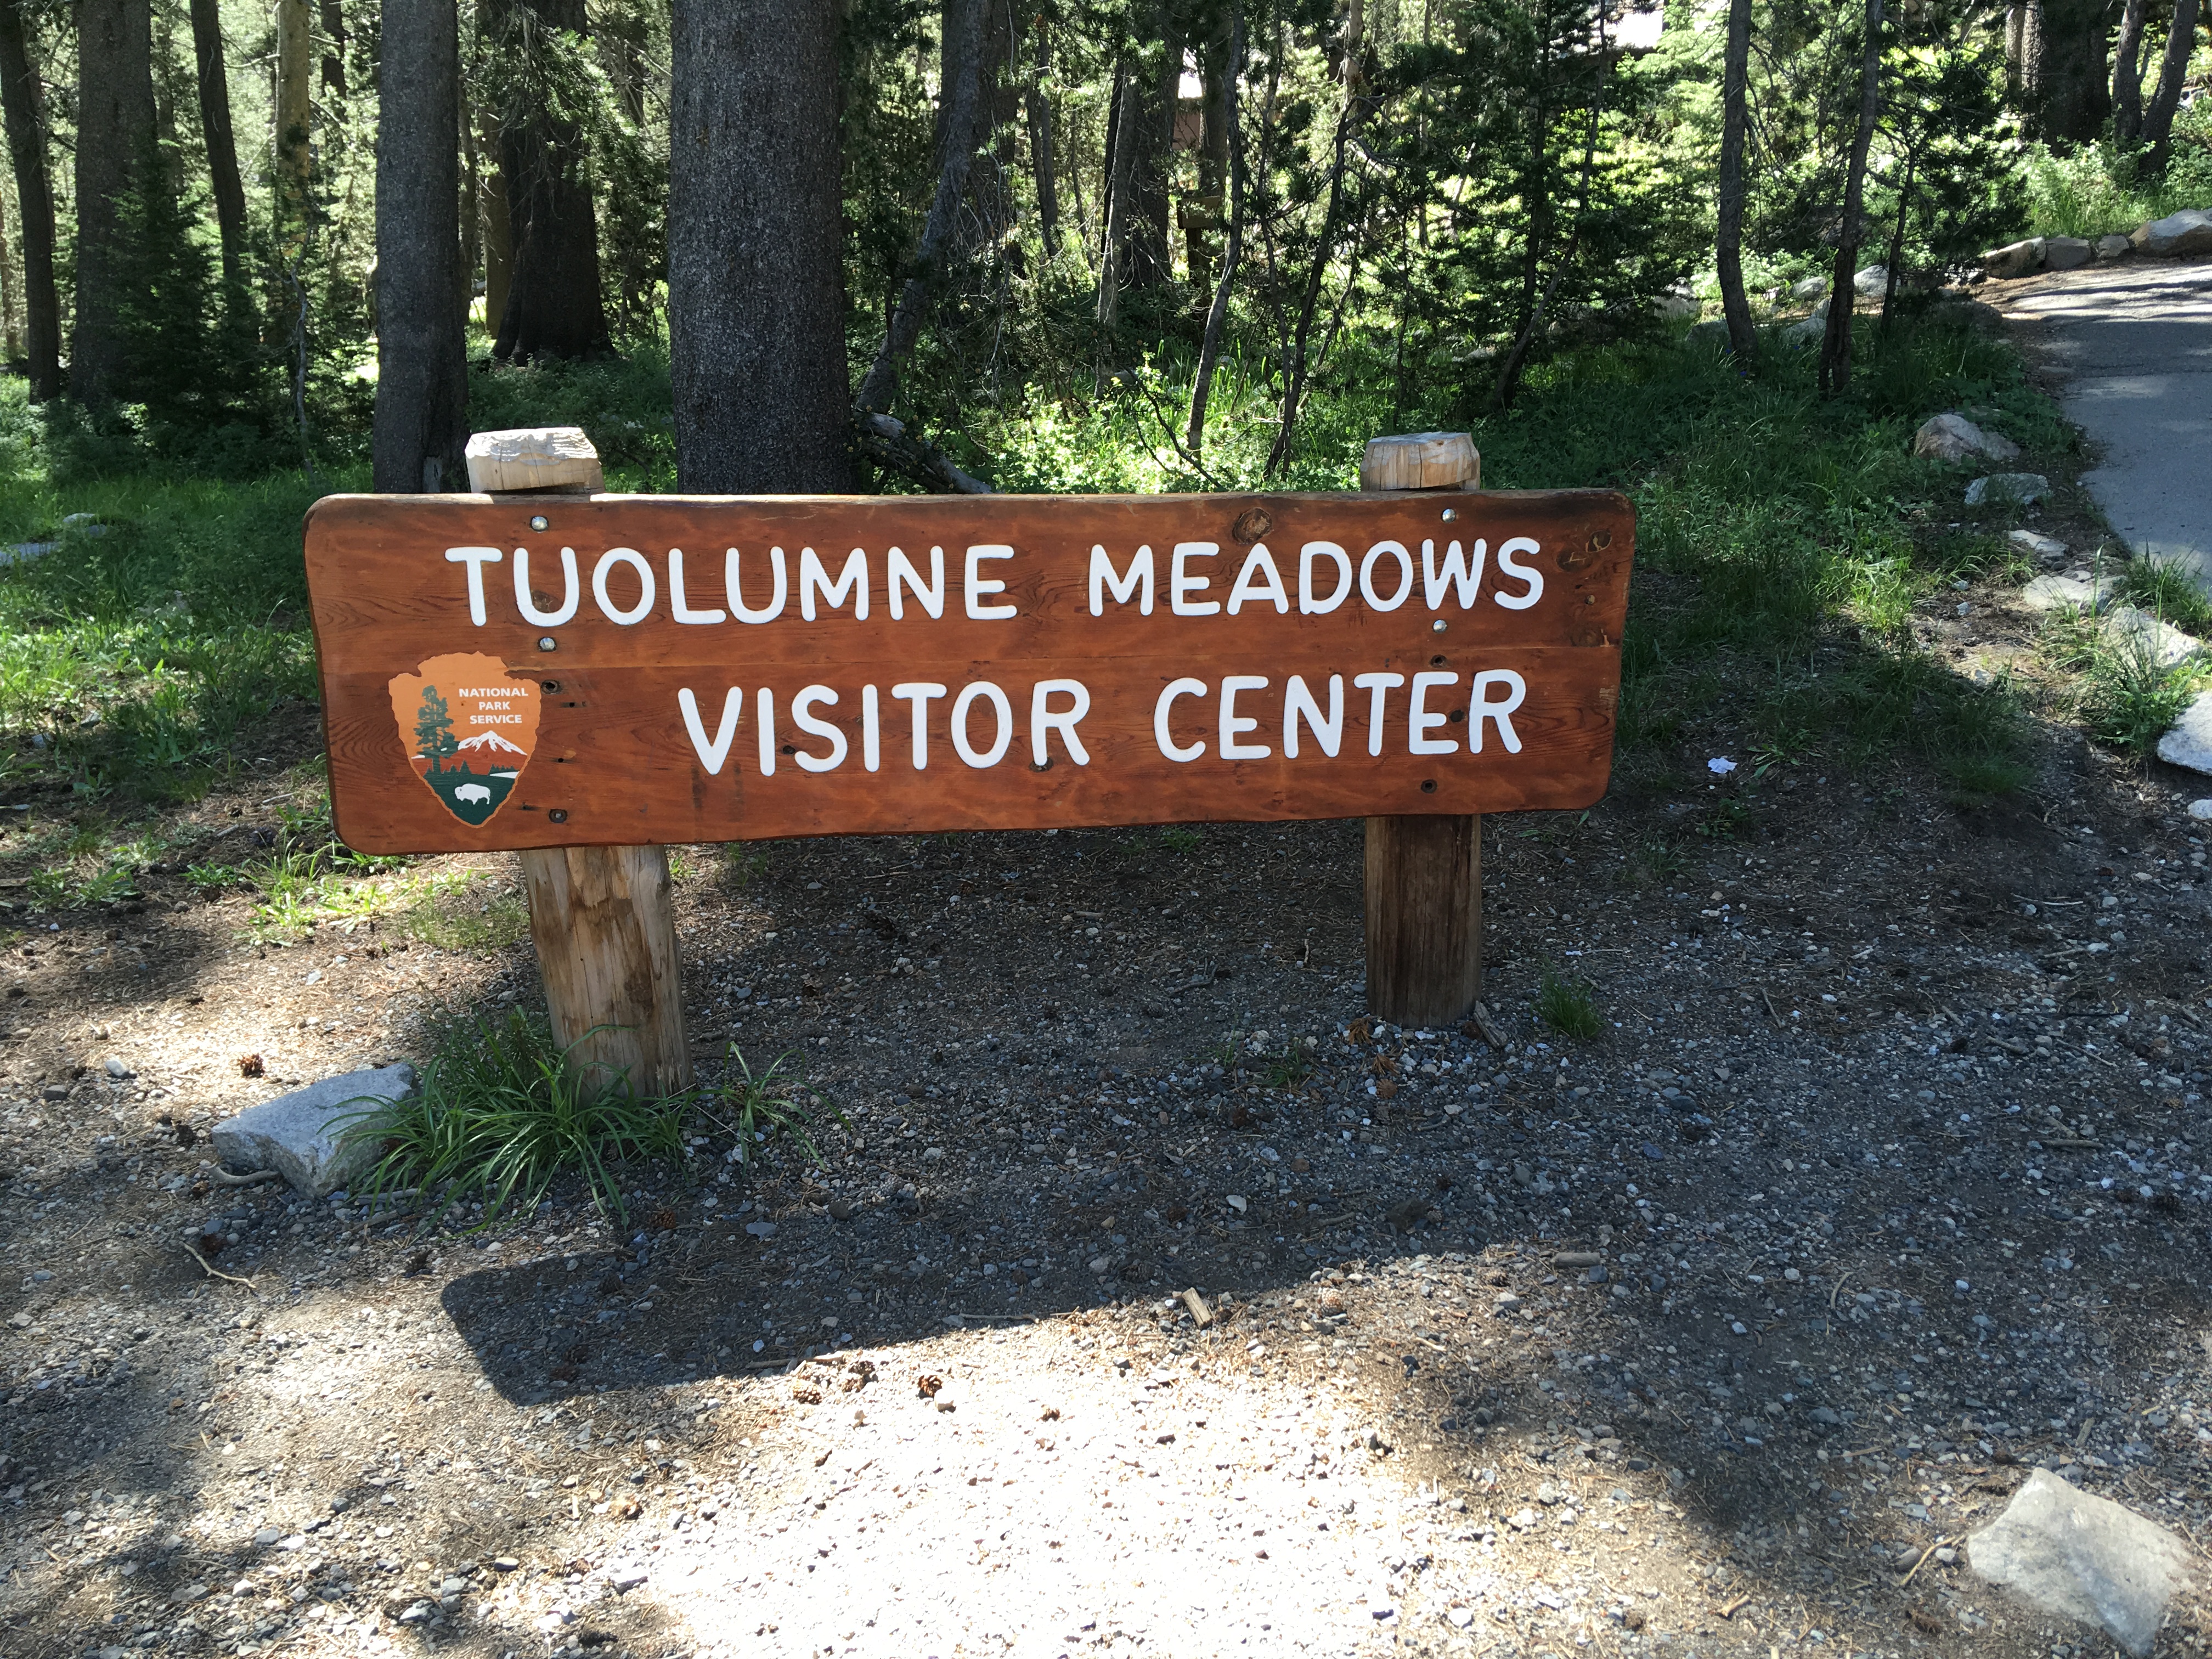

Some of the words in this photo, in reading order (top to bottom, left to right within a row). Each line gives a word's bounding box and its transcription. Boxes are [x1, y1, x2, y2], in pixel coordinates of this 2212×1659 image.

[445, 545, 1017, 627] TUOLUMNE
[1089, 538, 1543, 616] MEADOWS
[459, 688, 529, 697] NATIONAL
[478, 701, 511, 710] PARK
[470, 714, 522, 724] SERVICE
[678, 679, 1090, 776] VISITOR
[1154, 669, 1526, 762] CENTER
